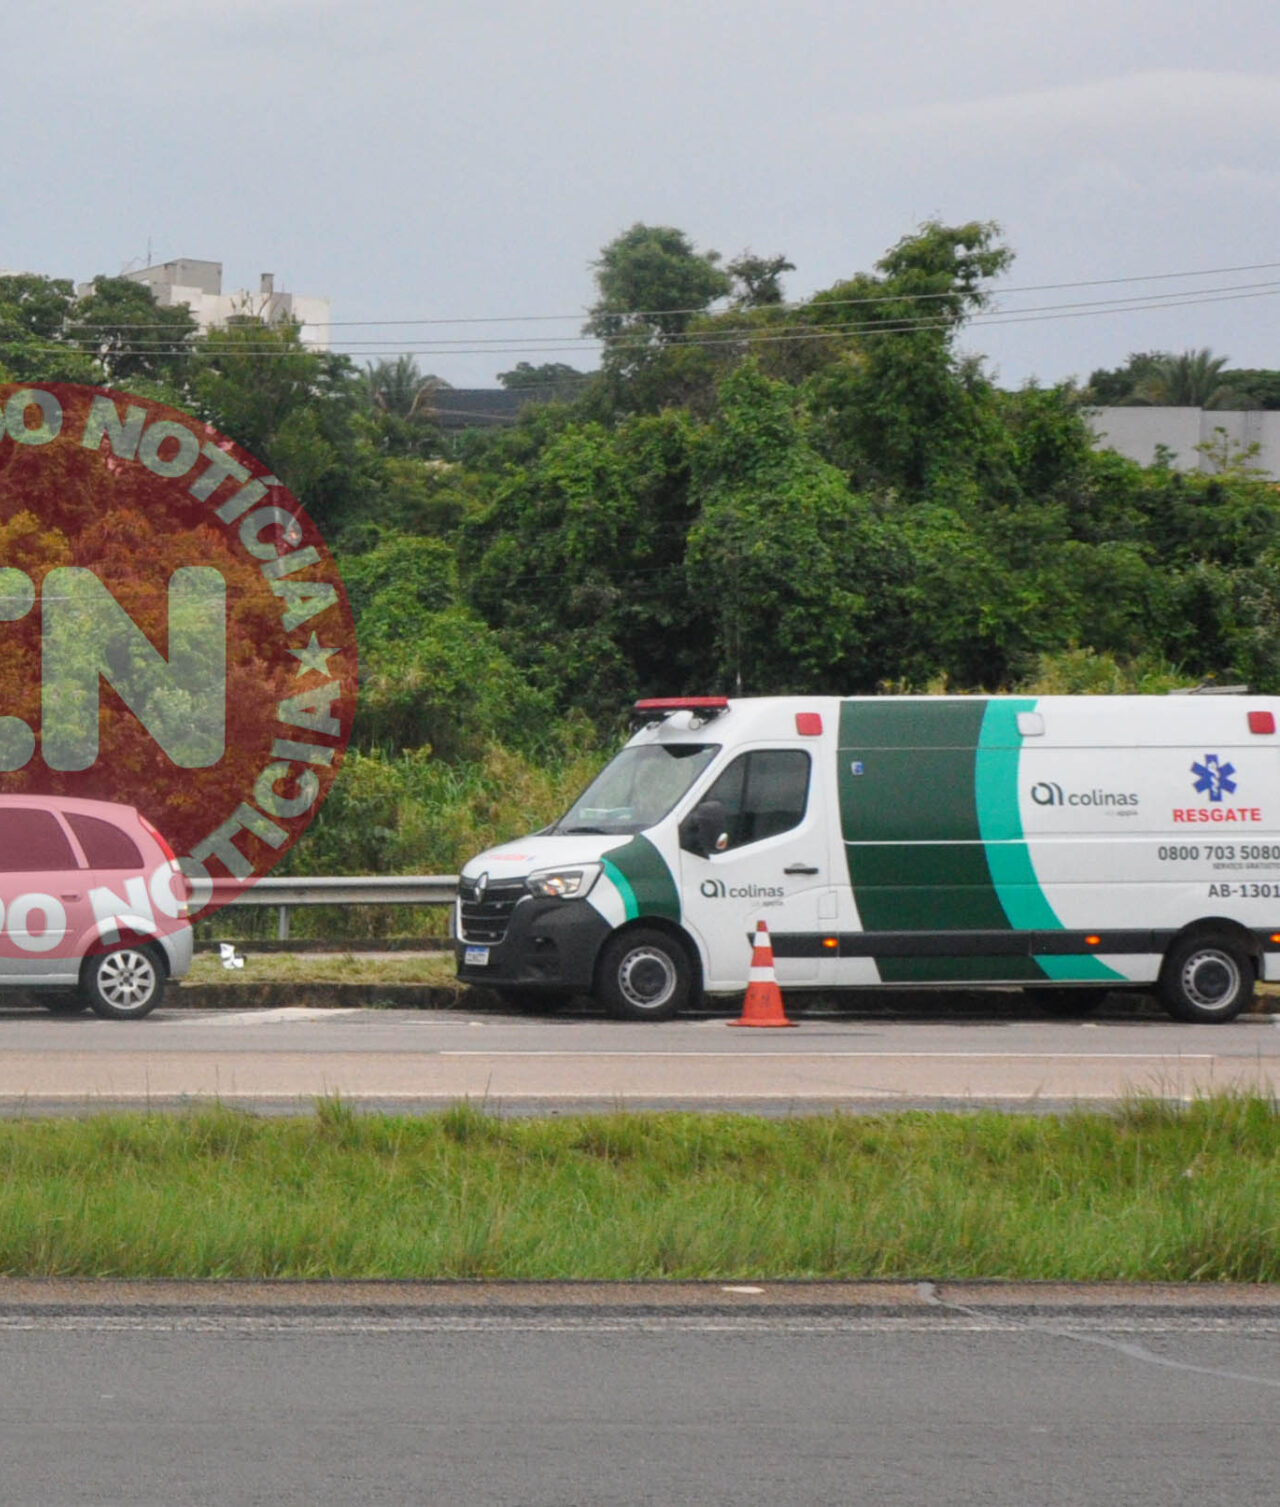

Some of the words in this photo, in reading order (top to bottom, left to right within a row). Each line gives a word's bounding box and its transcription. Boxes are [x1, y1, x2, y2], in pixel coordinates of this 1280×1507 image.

[1068, 789, 1139, 806] colinas
[1172, 808, 1262, 822] RESGATE
[1158, 846, 1199, 860] 0800
[1204, 846, 1235, 860] 703
[1240, 846, 1280, 860] 5080
[729, 884, 785, 898] colinas
[1208, 884, 1280, 898] AB-1301
